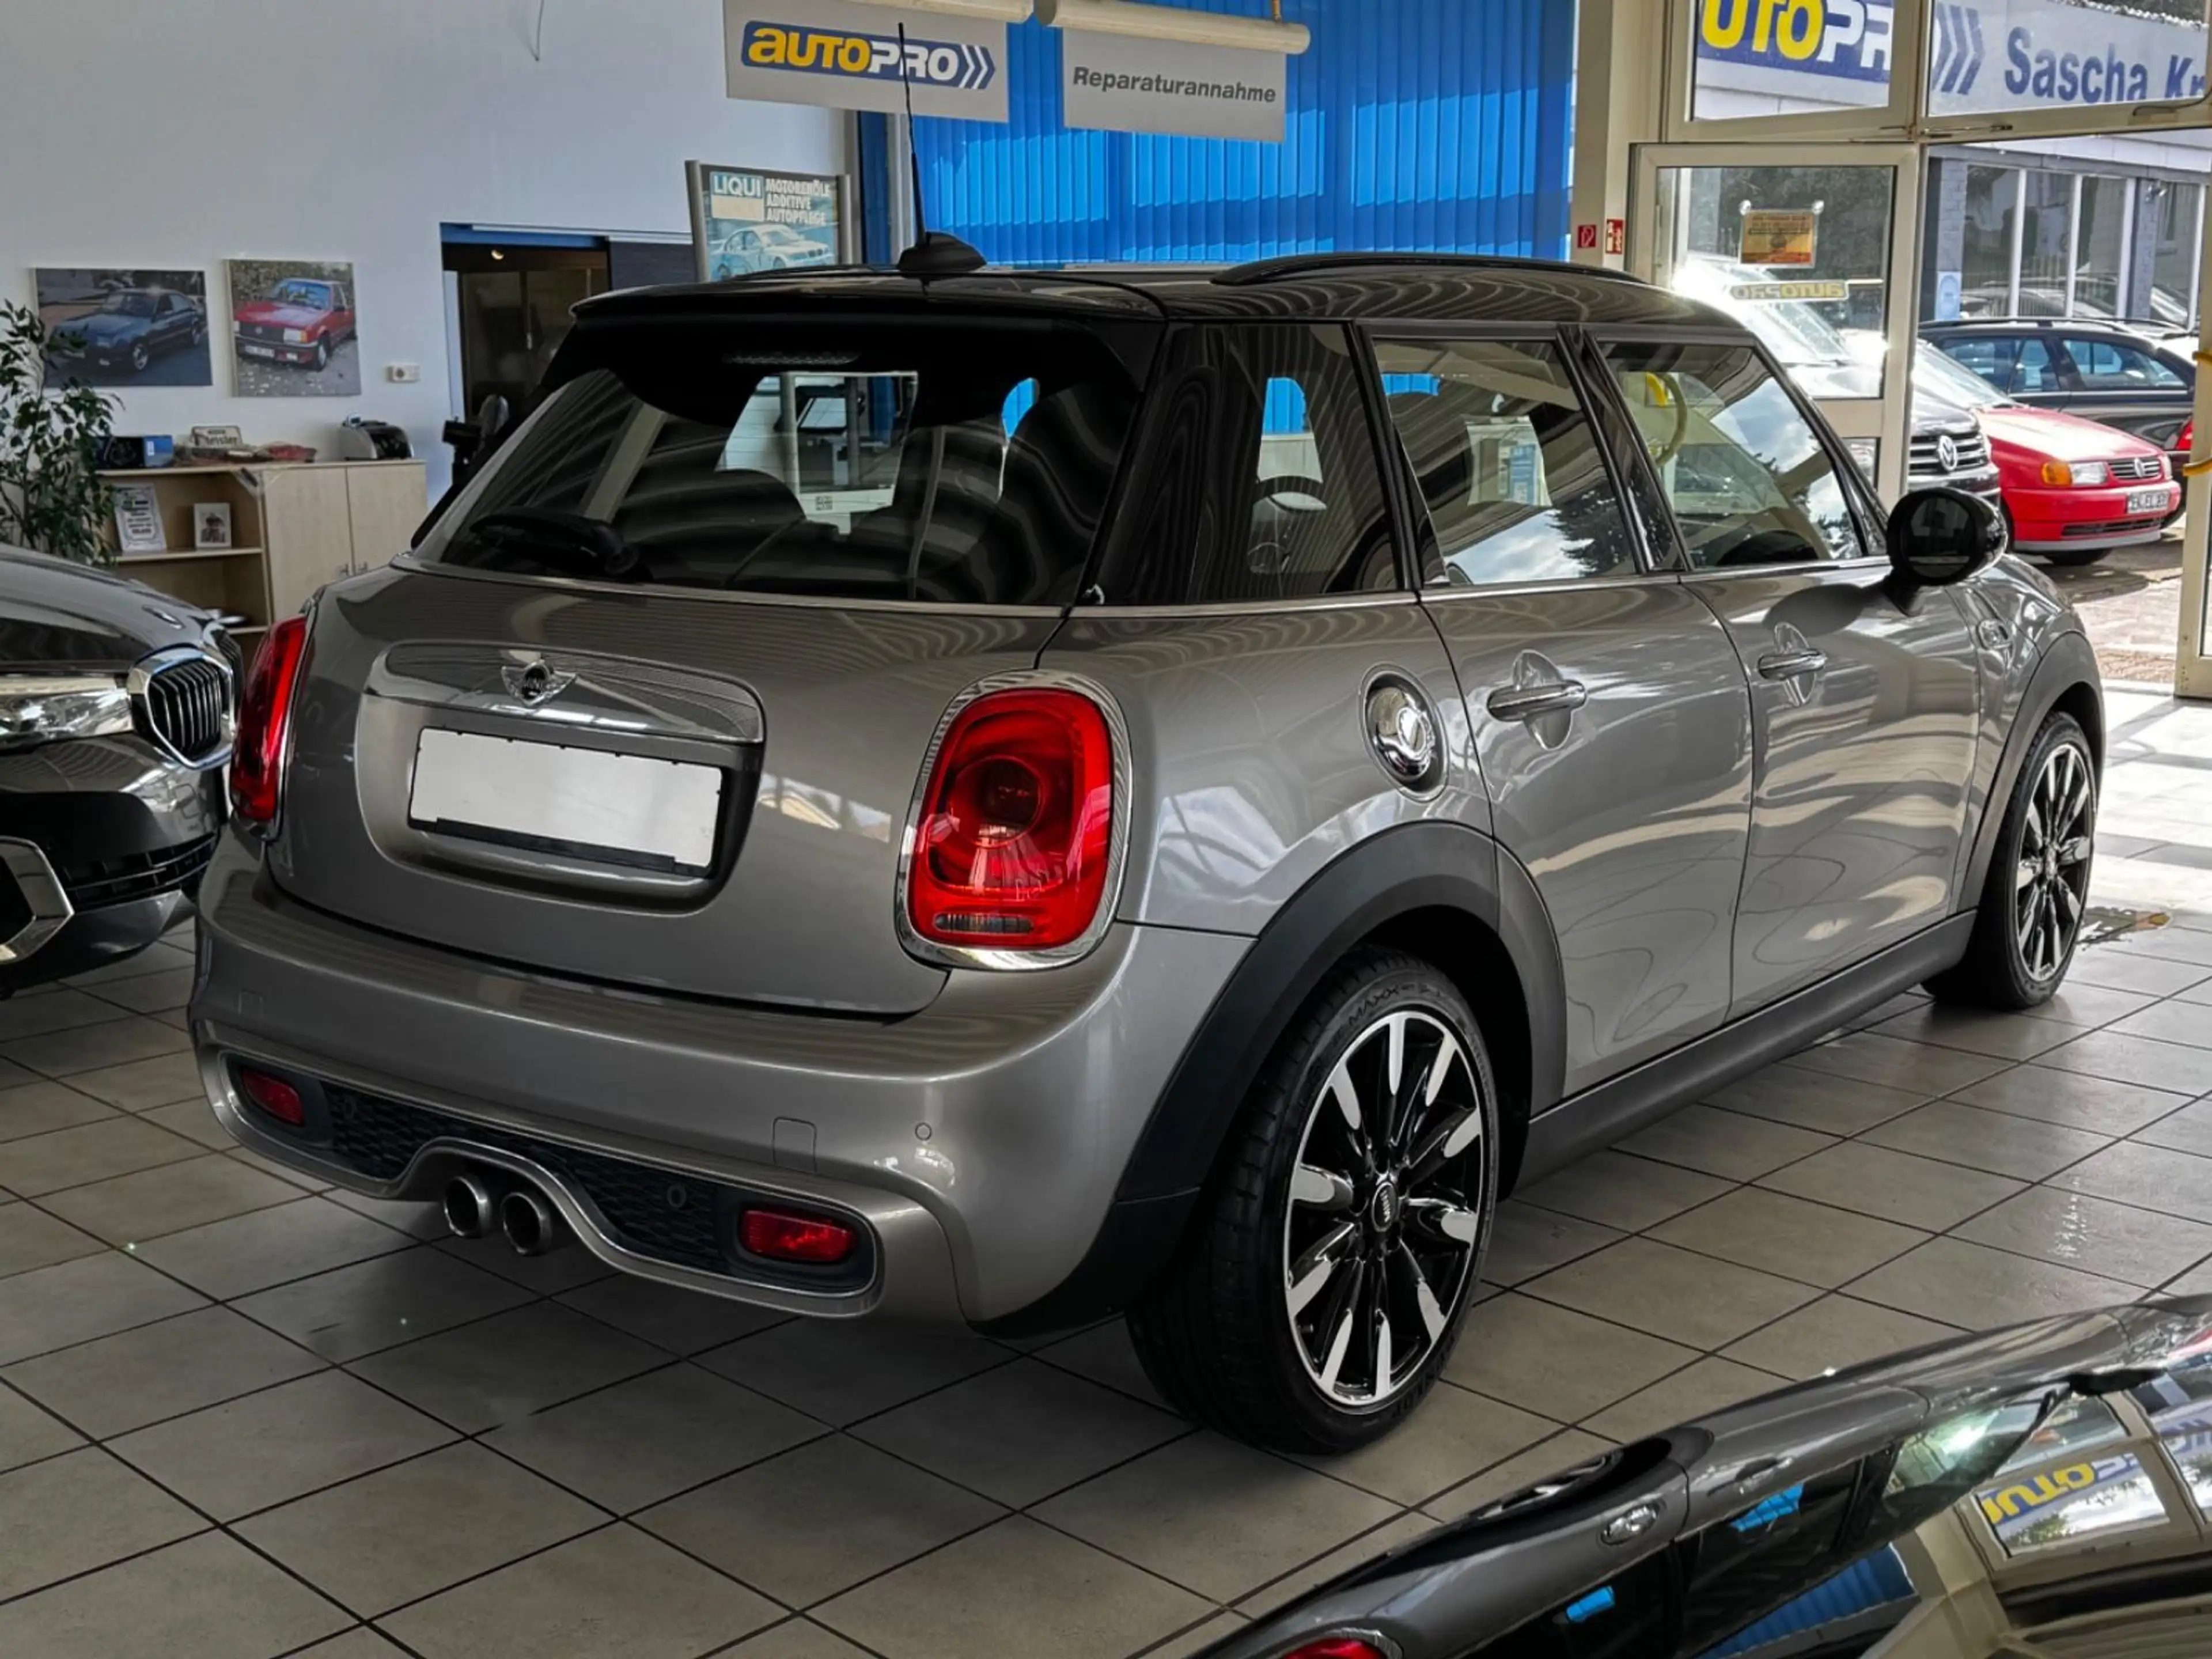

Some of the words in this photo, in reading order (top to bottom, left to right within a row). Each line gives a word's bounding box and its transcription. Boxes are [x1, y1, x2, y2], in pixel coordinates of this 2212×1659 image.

[2005, 26, 2147, 103] Sascha
[1073, 66, 1276, 102] Reparaturannahme
[714, 175, 761, 197] LIQUI
